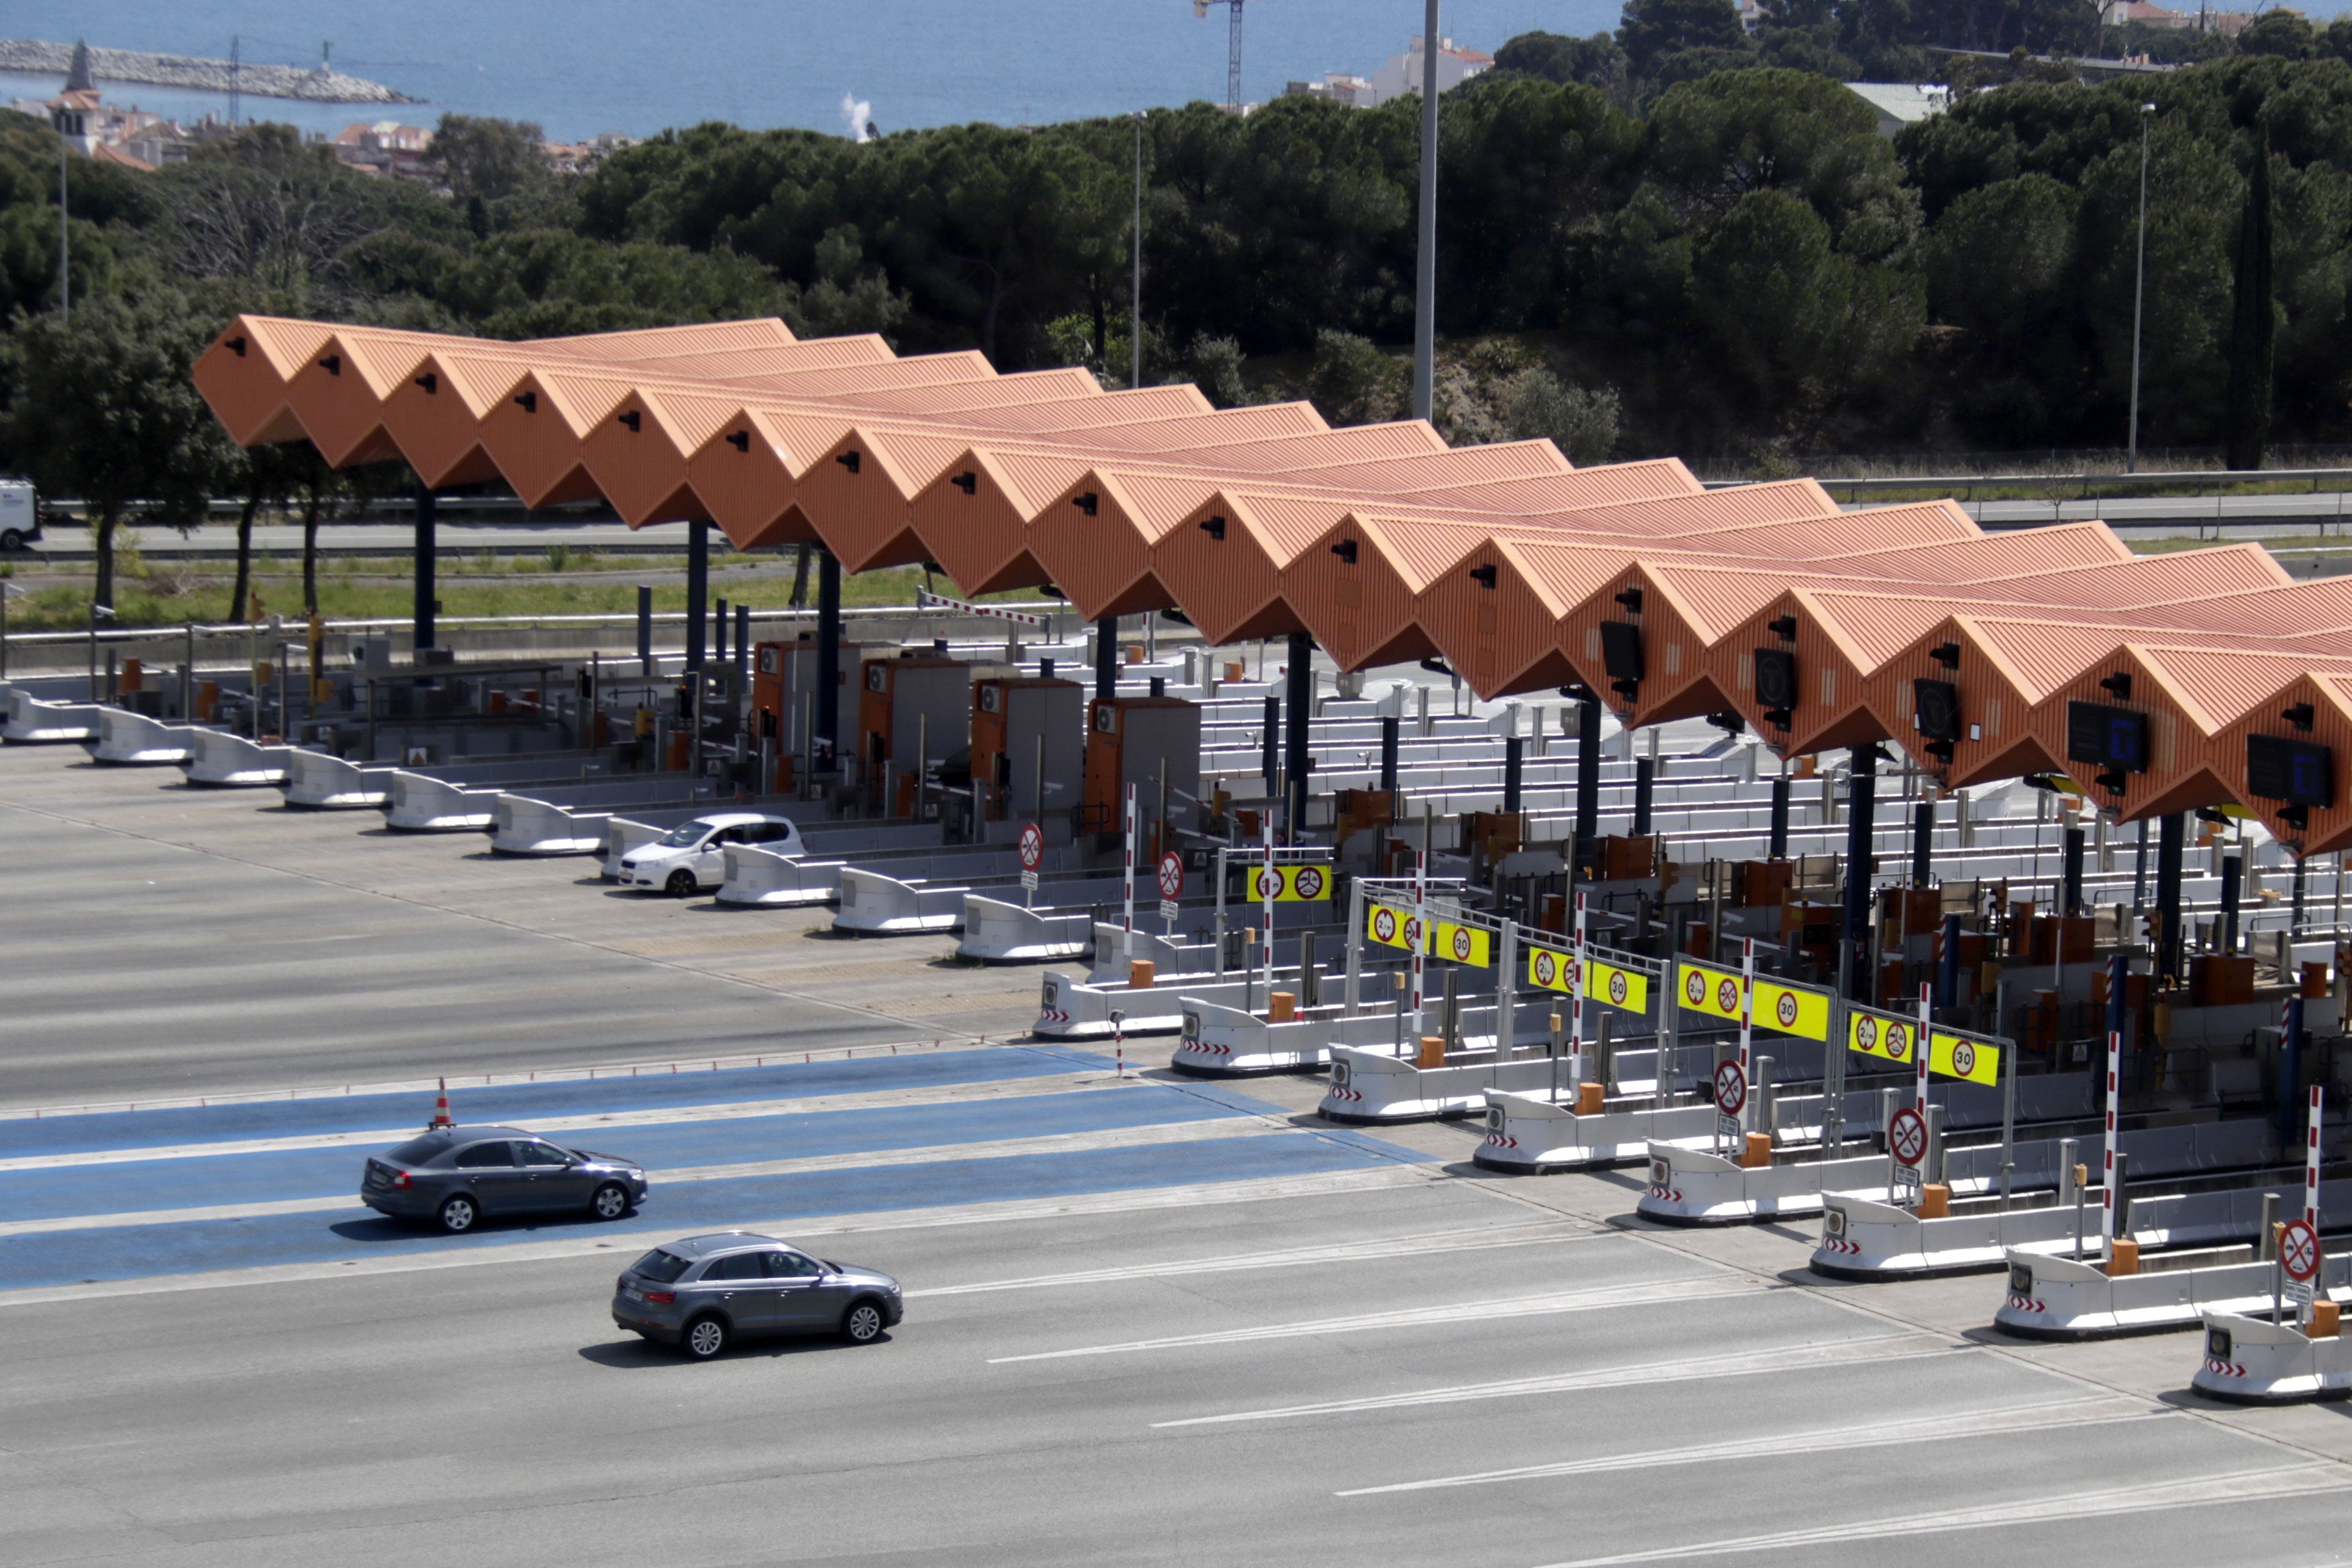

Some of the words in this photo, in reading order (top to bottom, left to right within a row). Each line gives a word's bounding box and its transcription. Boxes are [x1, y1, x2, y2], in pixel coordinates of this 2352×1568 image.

[1456, 938, 1467, 951] 30
[1612, 981, 1624, 994] 30
[1781, 1003, 1793, 1016] 30
[1957, 1051, 1971, 1065] 30
